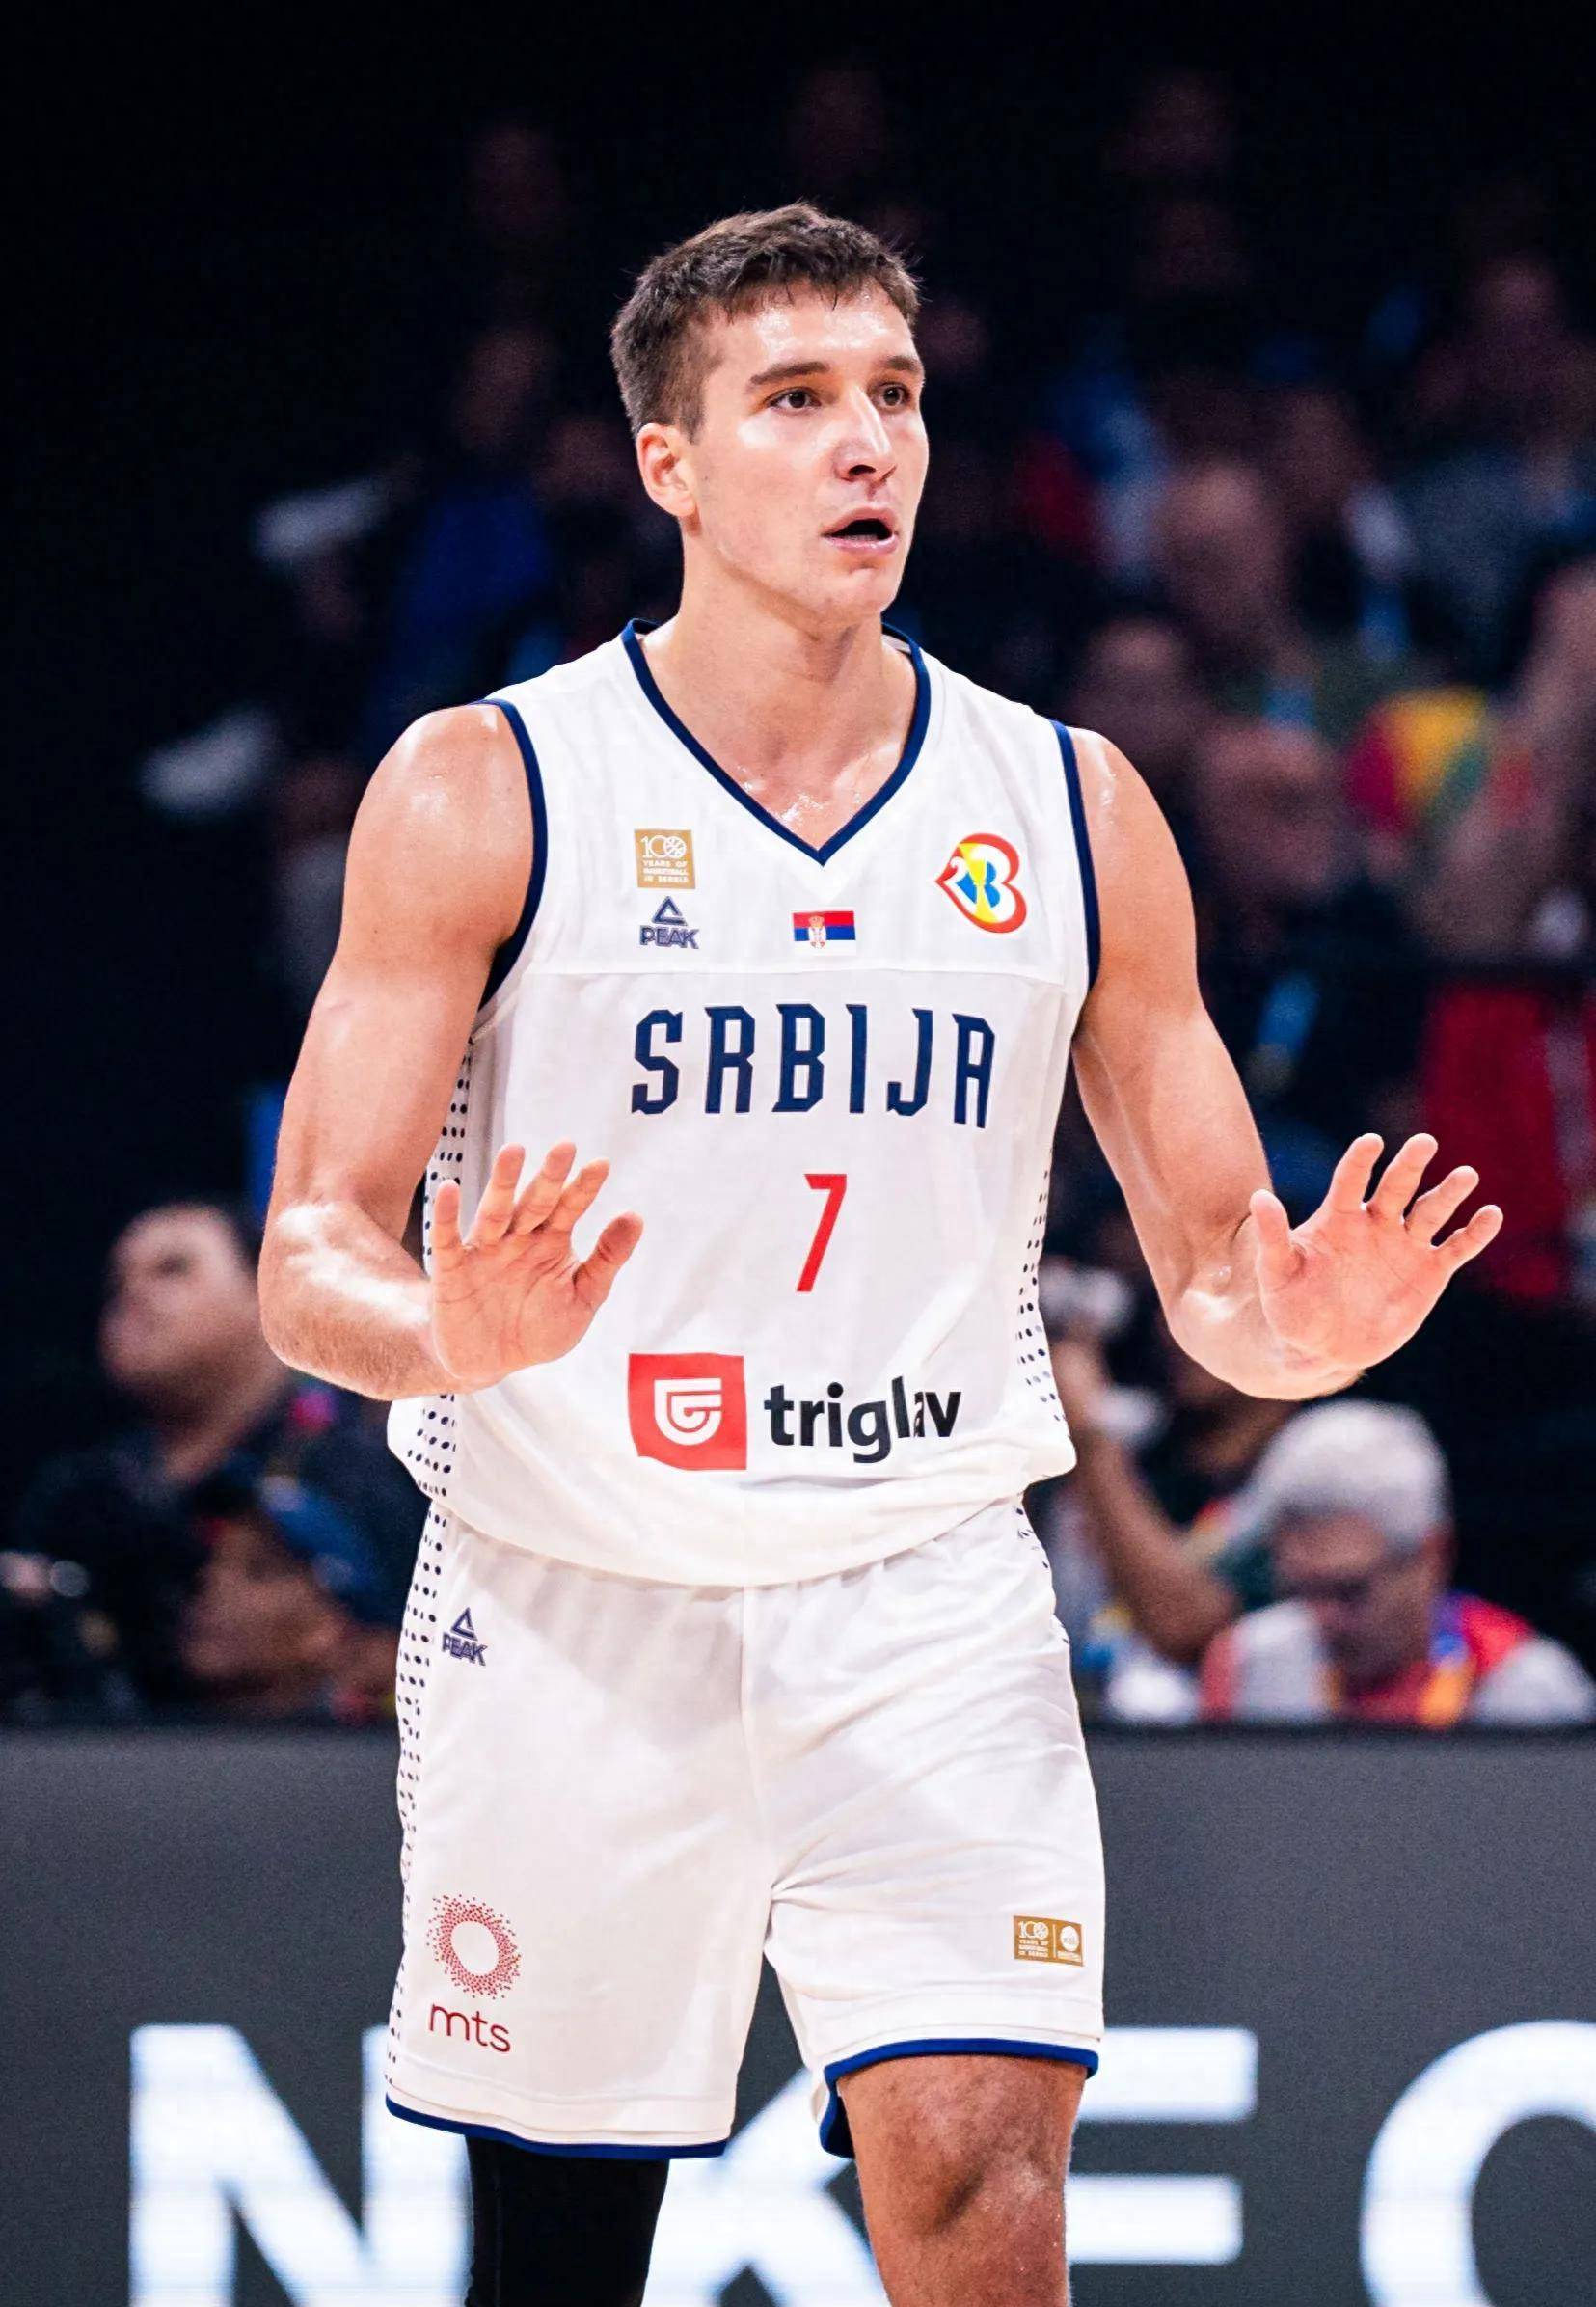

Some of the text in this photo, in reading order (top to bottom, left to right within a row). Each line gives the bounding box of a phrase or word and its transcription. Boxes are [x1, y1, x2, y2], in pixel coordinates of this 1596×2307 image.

[639, 925, 700, 950] PEAK
[631, 1003, 995, 1129] SRBIJA
[796, 1173, 848, 1292] 7
[764, 1376, 962, 1464] triglav
[442, 1631, 488, 1667] PEAK
[430, 2003, 511, 2053] mts
